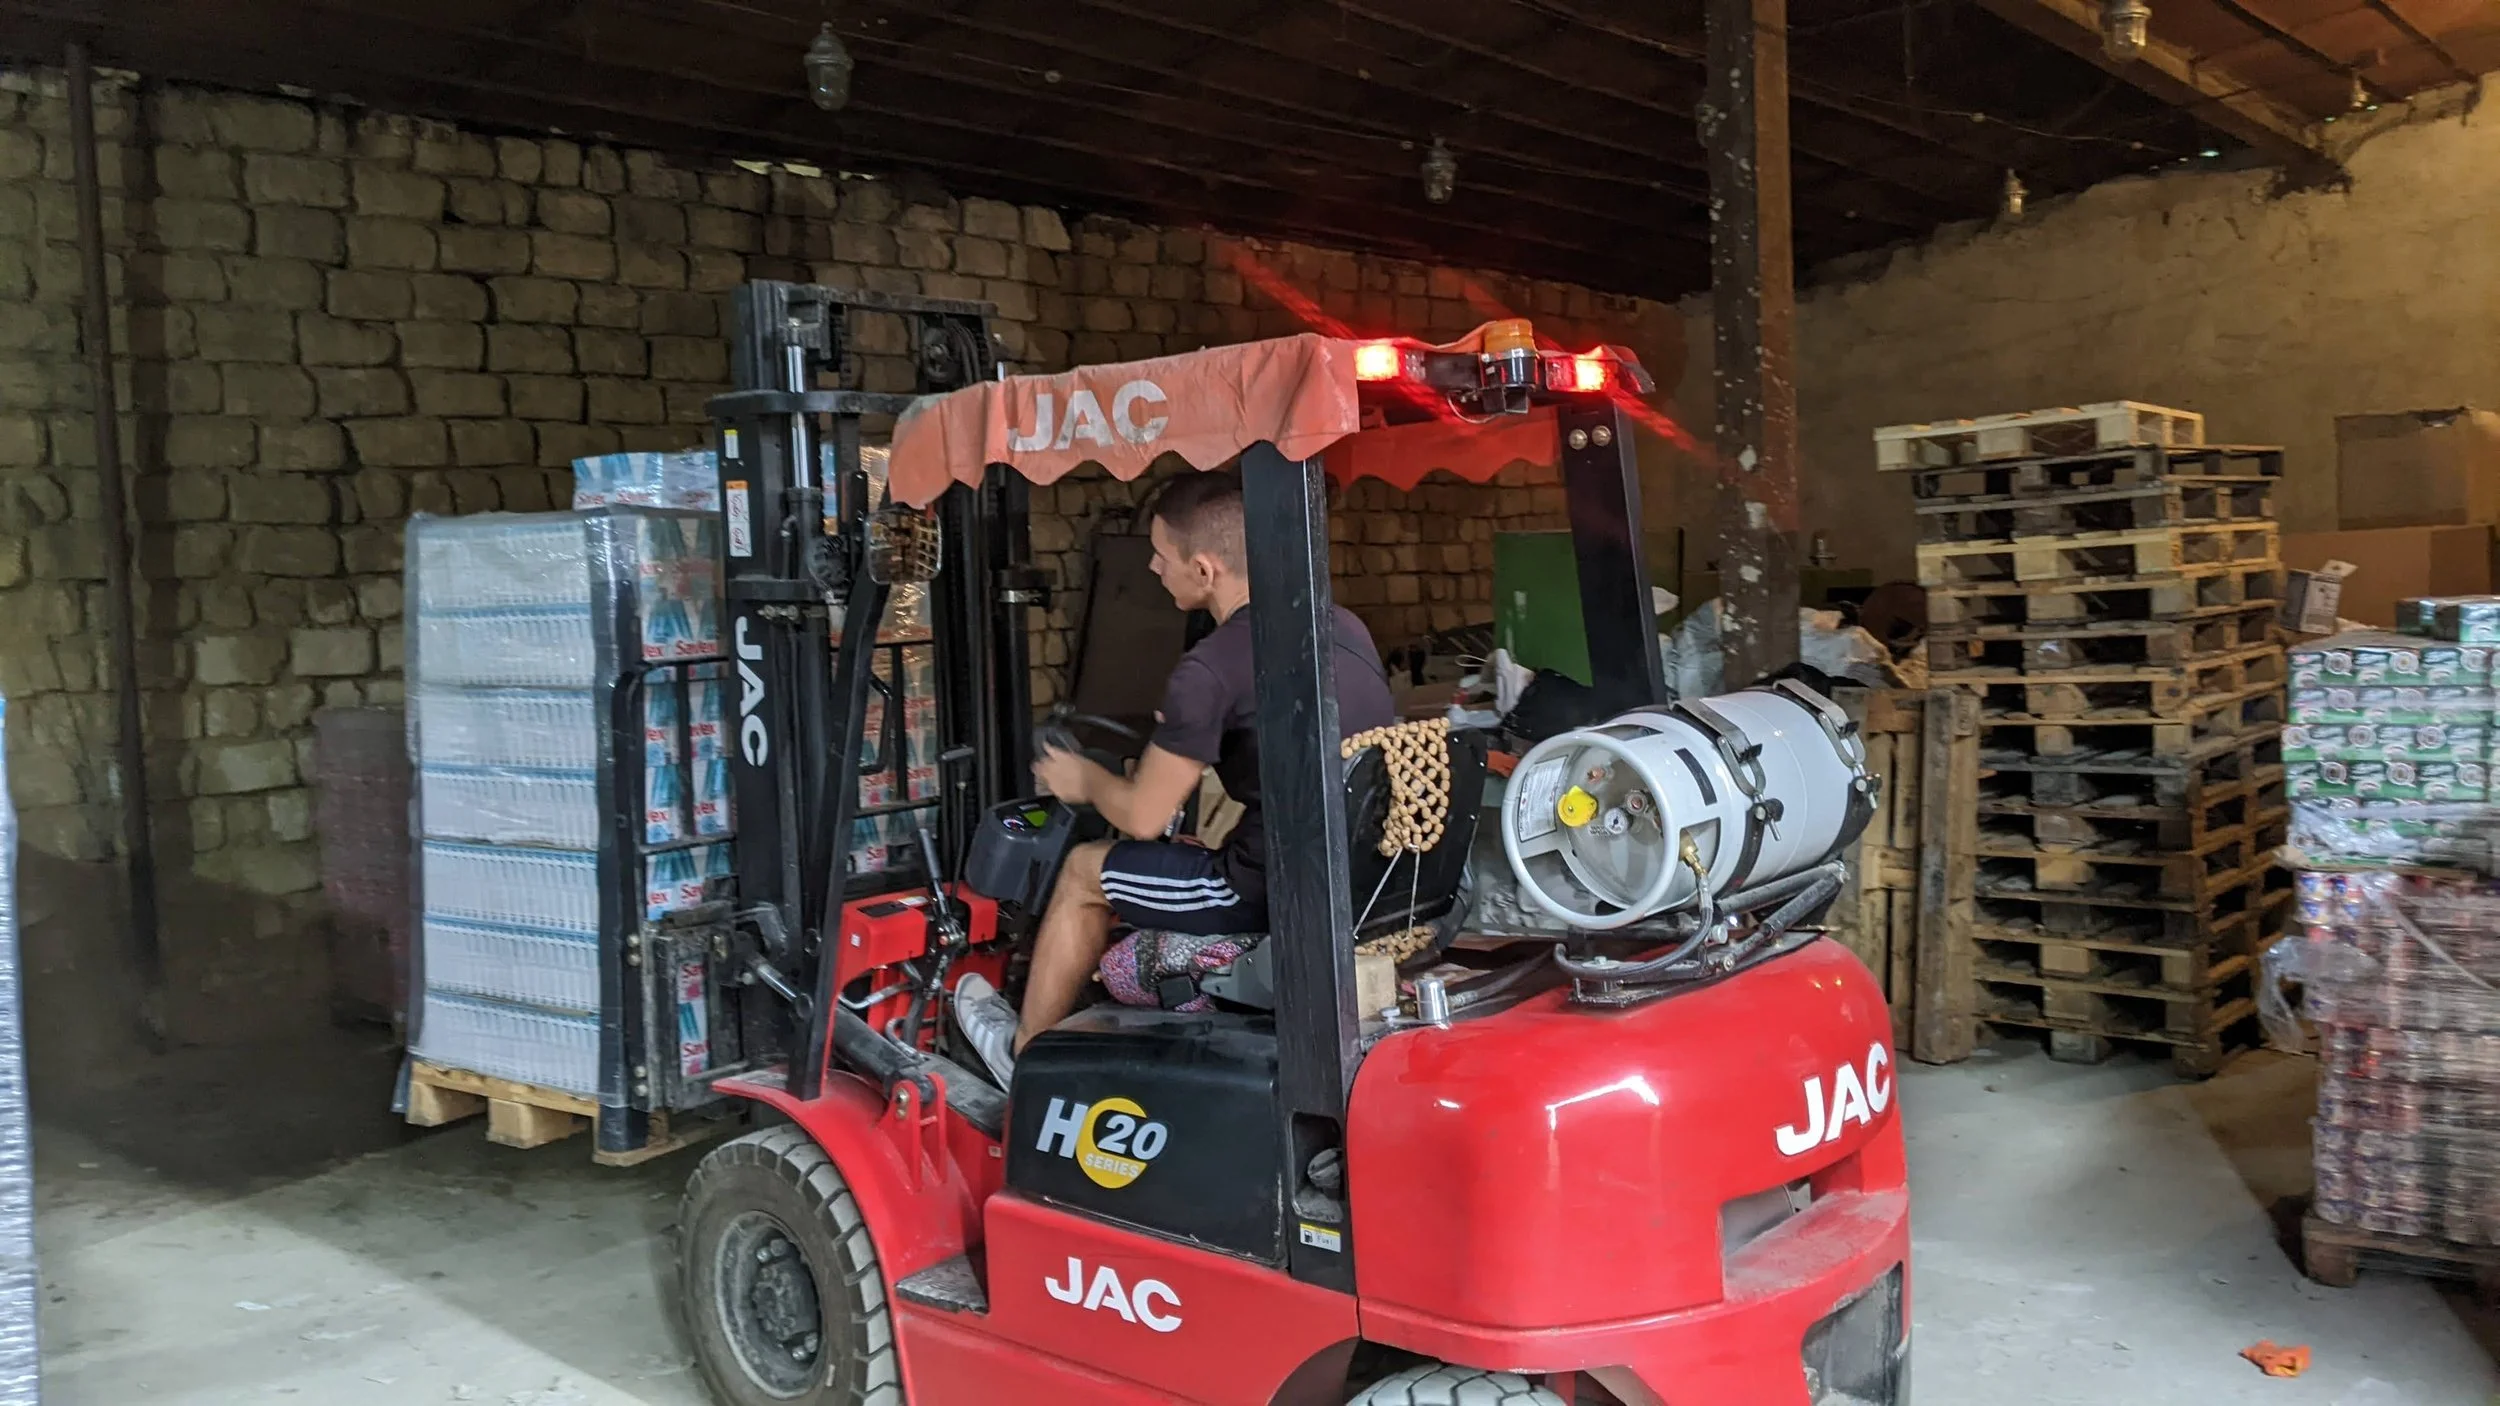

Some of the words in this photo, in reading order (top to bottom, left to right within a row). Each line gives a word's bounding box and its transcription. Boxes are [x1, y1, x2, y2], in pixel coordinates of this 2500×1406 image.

[1006, 378, 1170, 453] JAC
[735, 615, 769, 768] JAC
[1097, 1114, 1168, 1160] 20
[1775, 1042, 1890, 1156] JAC
[1085, 1153, 1140, 1179] SERIES
[1044, 1256, 1183, 1333] JAC
